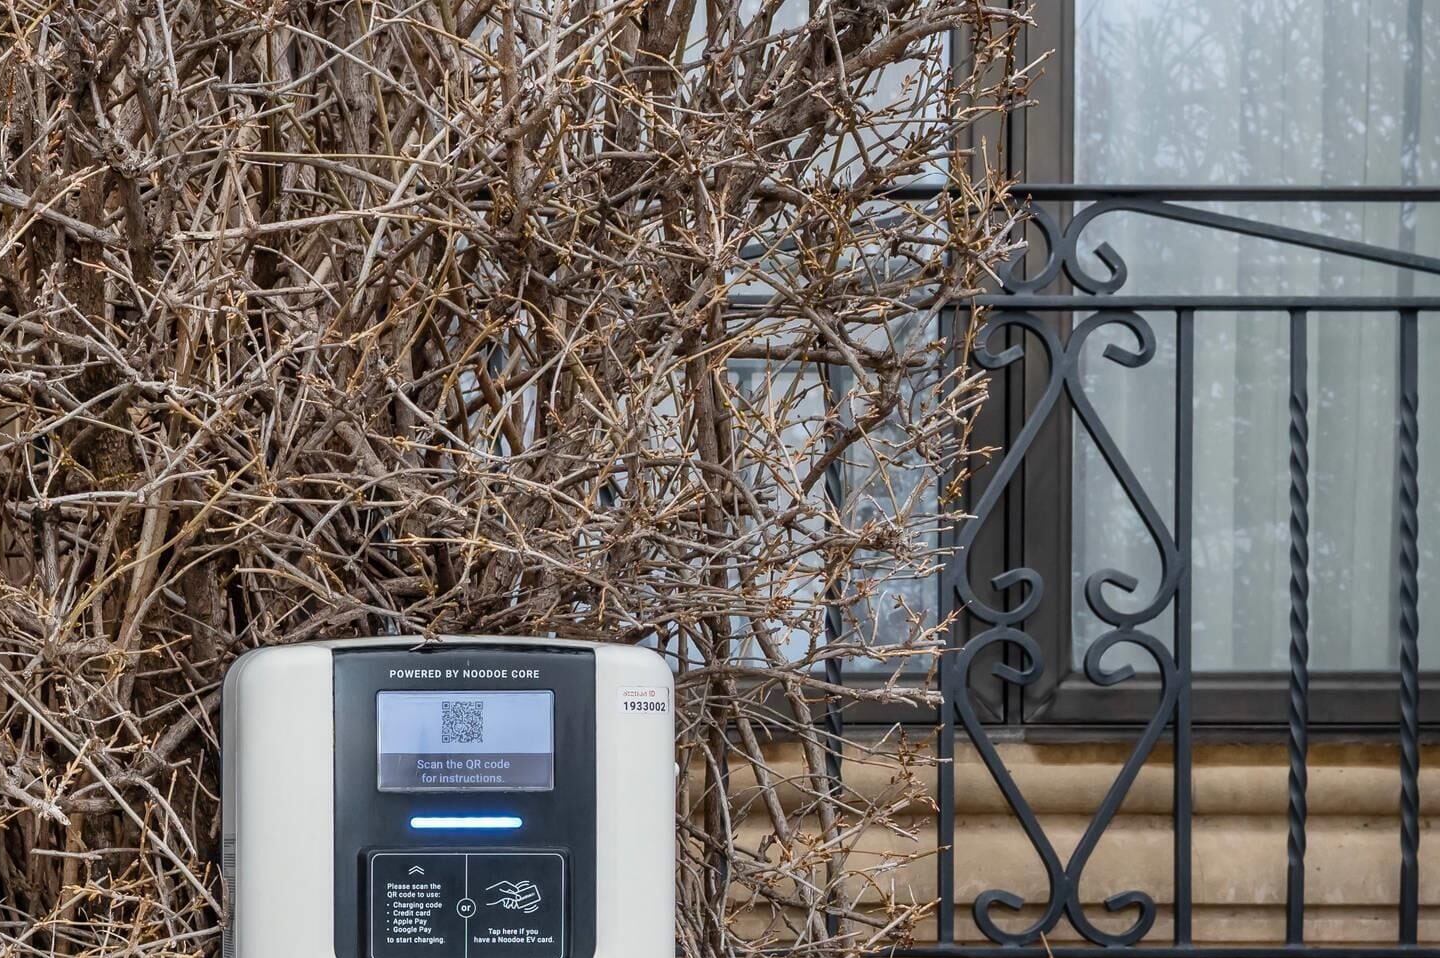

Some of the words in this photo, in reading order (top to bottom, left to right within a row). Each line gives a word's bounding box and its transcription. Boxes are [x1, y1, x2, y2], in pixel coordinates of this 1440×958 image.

[390, 670, 441, 679] POWERED
[446, 670, 459, 679] BY
[463, 670, 508, 679] NOODOE
[511, 670, 539, 679] CORE
[624, 701, 666, 711] 1933002
[417, 760, 443, 769] Scan
[446, 760, 463, 769] the
[466, 760, 481, 769] QR
[484, 760, 510, 769] code
[422, 774, 437, 783] for
[440, 774, 504, 783] instructions.
